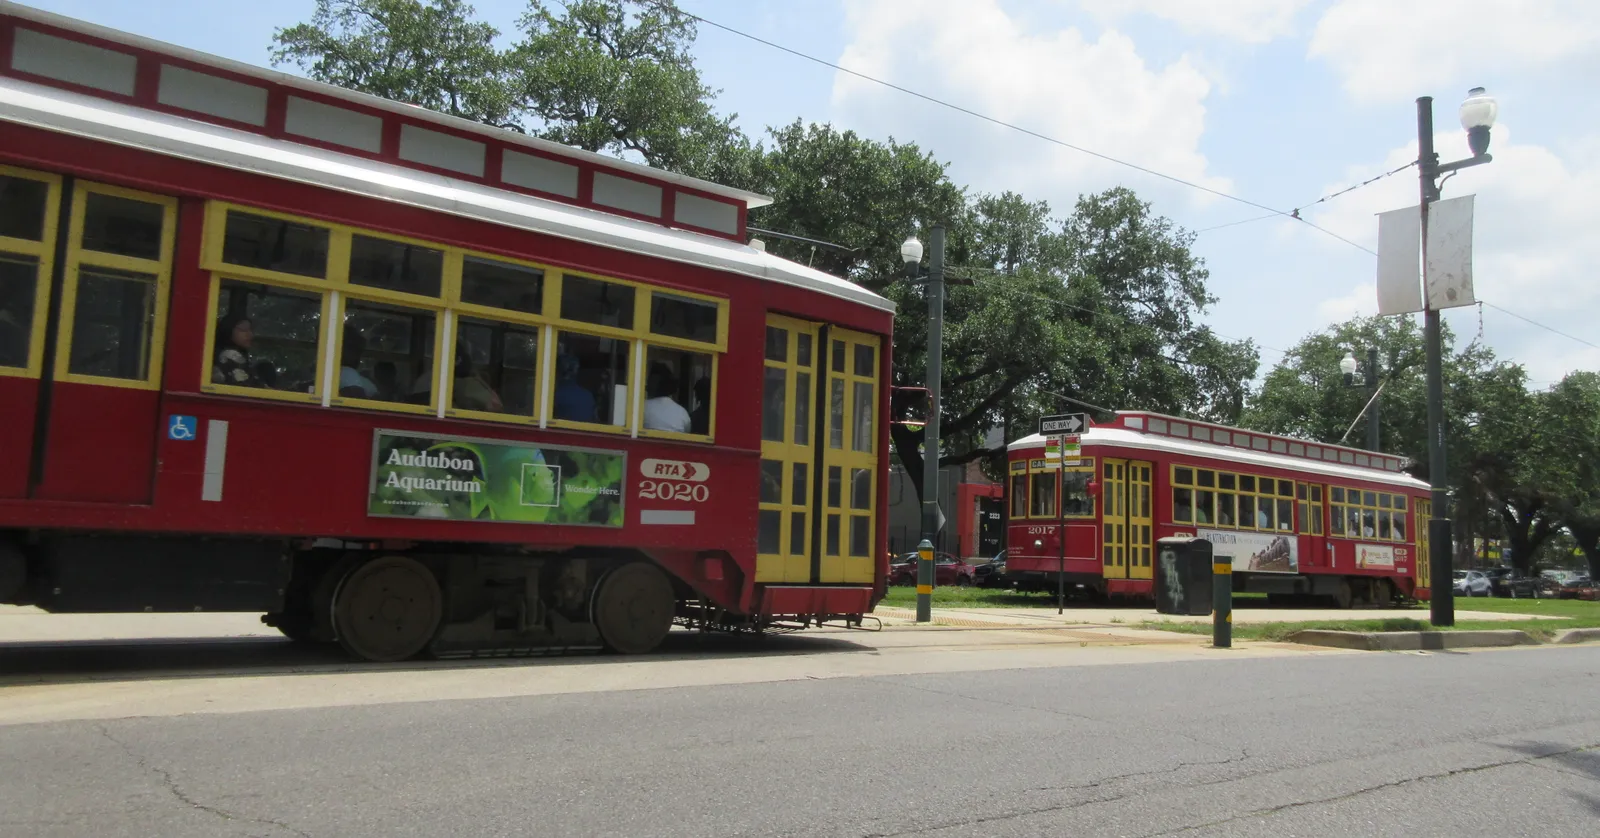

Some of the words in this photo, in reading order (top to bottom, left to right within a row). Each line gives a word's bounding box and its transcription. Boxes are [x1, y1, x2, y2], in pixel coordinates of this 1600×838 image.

[1043, 422, 1056, 431] ONE
[1057, 420, 1071, 430] WAY
[387, 448, 475, 471] Audubon
[653, 463, 681, 477] RTA
[385, 471, 482, 494] Aquarium
[565, 484, 598, 495] Wonder
[598, 486, 620, 497] Here.
[638, 480, 710, 503] 2020
[1028, 526, 1055, 535] 2017
